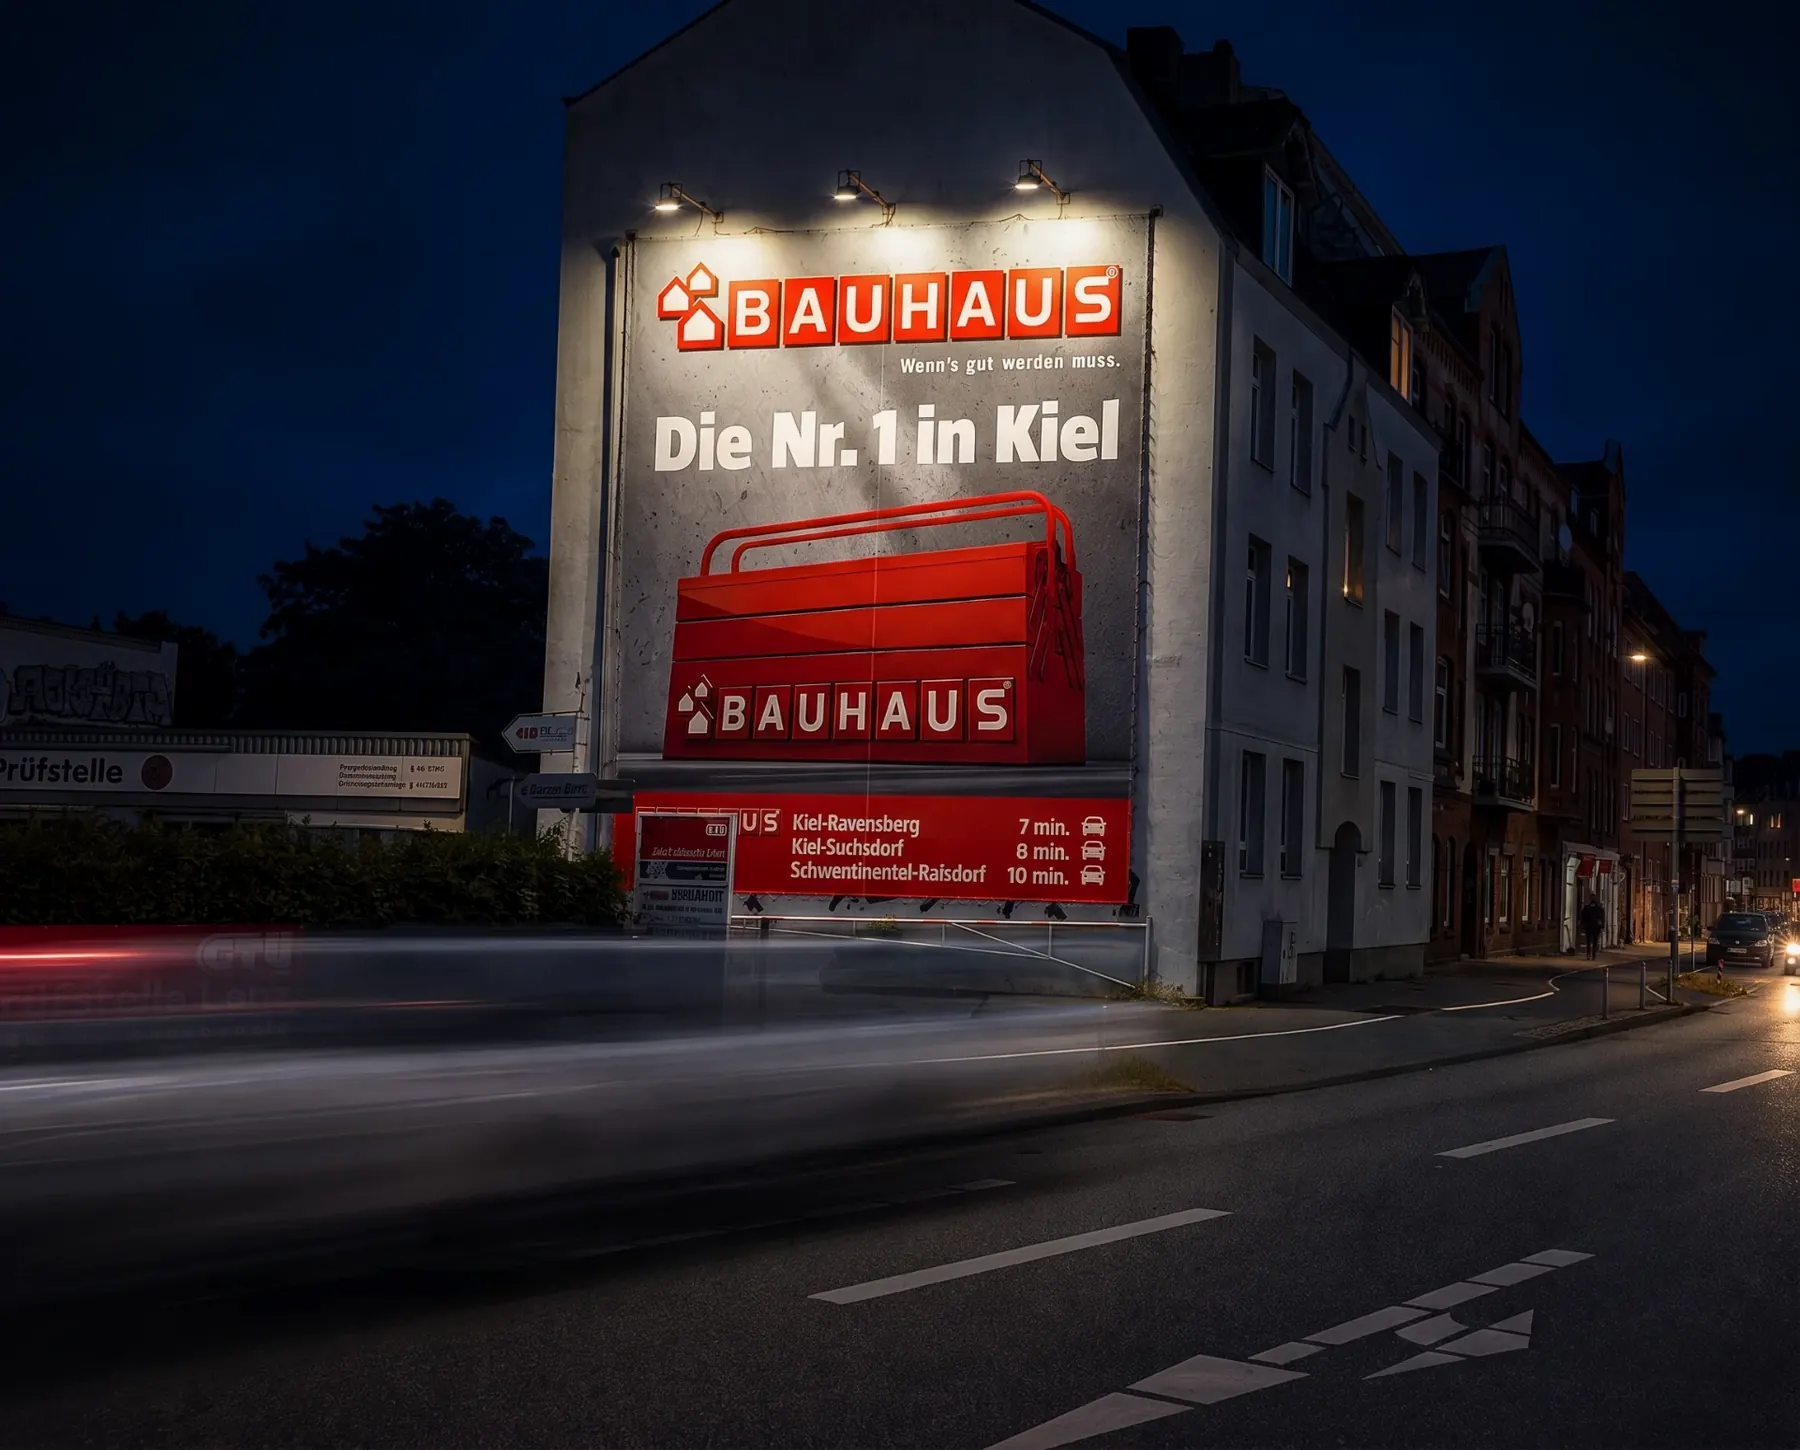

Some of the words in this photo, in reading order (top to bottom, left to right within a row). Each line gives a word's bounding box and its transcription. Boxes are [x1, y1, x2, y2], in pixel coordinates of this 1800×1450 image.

[735, 275, 1113, 336] BAUHAUS
[900, 357, 959, 374] Wenn's
[966, 357, 994, 375] gut
[1002, 354, 1064, 370] werden
[1072, 355, 1121, 369] muss.
[655, 411, 753, 472] Die
[771, 410, 858, 469] Nr.
[872, 409, 897, 465] 1
[917, 404, 976, 465] in
[995, 399, 1120, 463] Kiel
[721, 687, 1009, 732] BAUHAUS
[0, 757, 123, 784] Prüfstelle
[792, 814, 920, 838] Kiel-Ravensberg
[1018, 818, 1030, 835] 7
[1033, 818, 1070, 836] min.
[791, 838, 905, 857] Kiel-Suchsdorf
[1016, 843, 1028, 860] 8
[1033, 843, 1069, 860] min.
[1007, 867, 1027, 884] 10
[1032, 867, 1069, 885] min.
